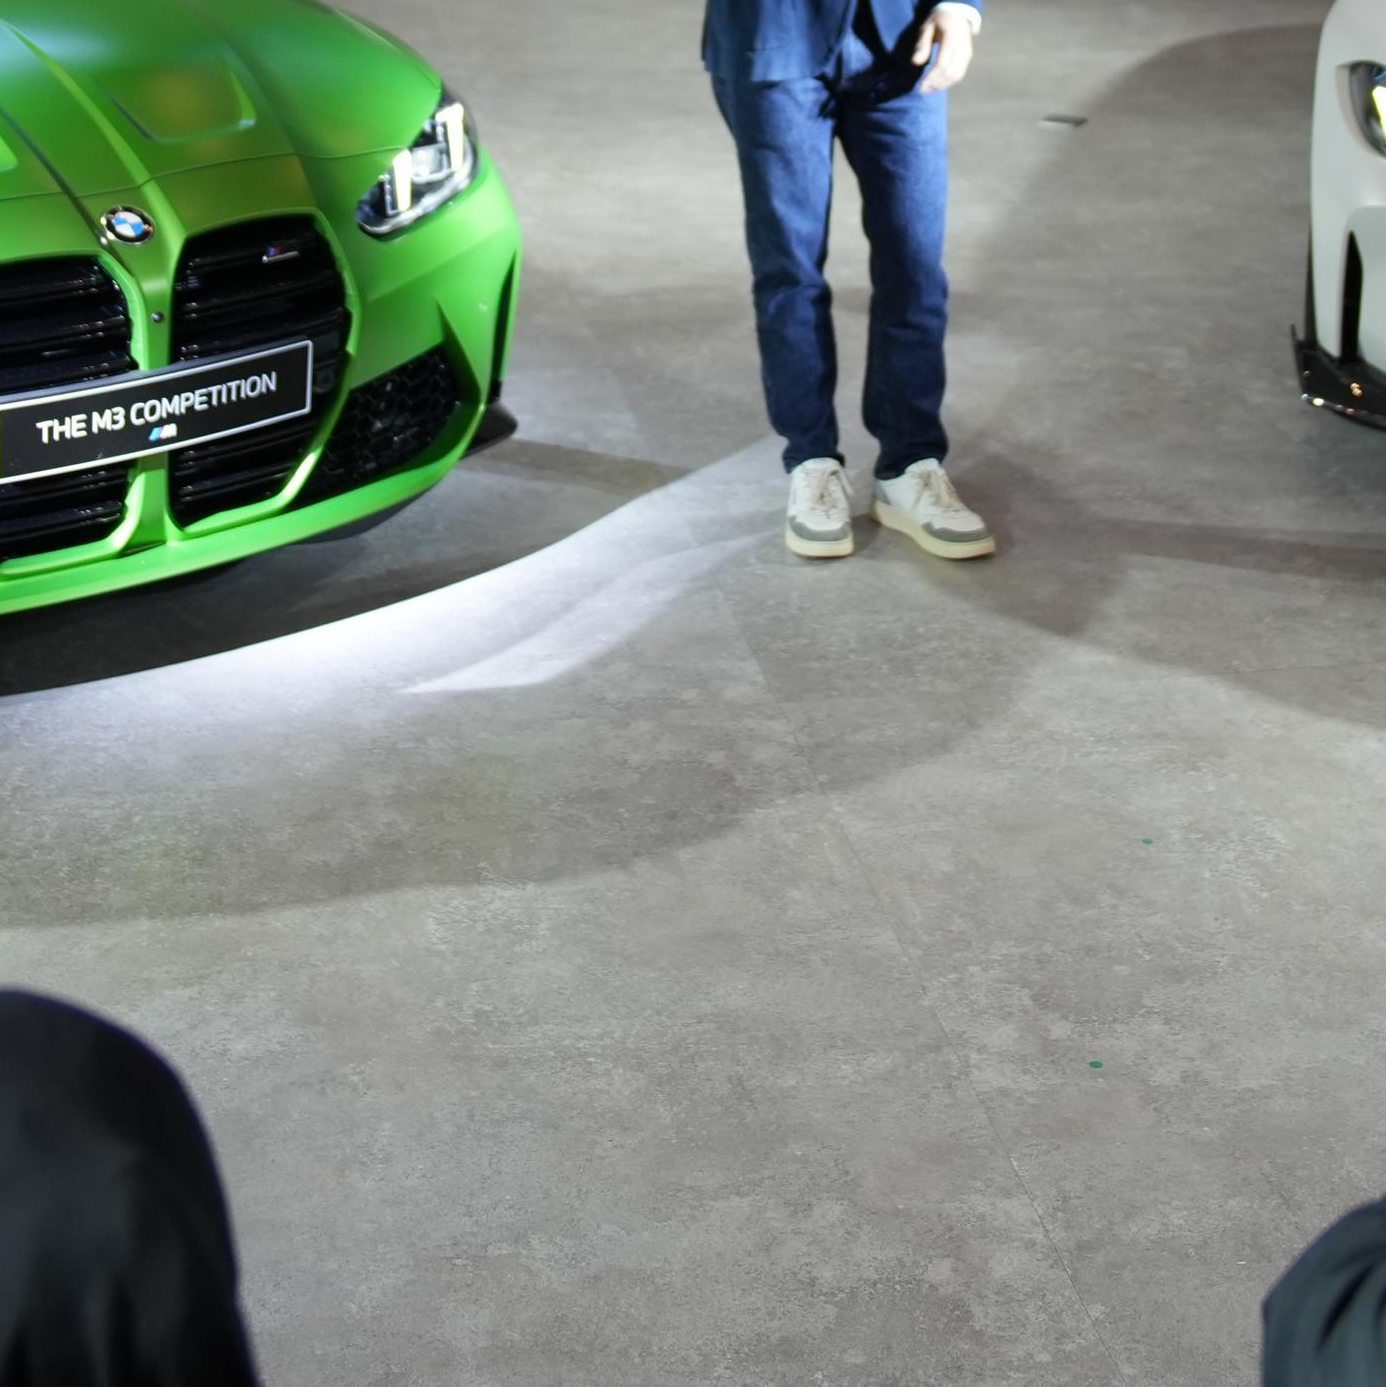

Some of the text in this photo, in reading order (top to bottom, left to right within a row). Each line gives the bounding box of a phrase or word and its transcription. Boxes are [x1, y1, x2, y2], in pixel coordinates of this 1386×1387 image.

[35, 371, 277, 444] THE M3 COMPETITION
